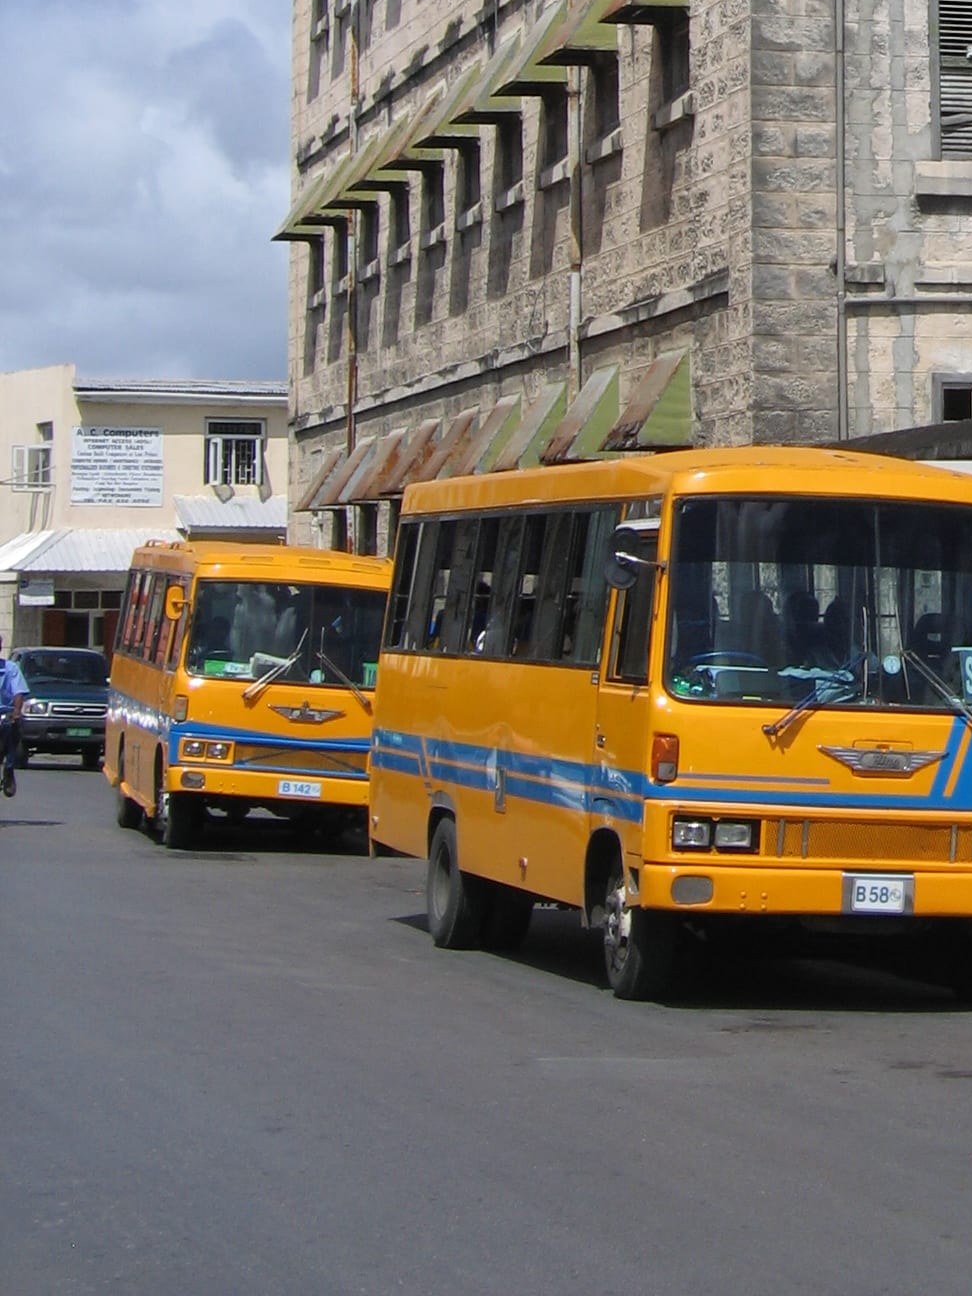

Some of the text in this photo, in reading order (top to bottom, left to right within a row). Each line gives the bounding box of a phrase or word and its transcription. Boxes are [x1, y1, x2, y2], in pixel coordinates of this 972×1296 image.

[104, 429, 160, 438] Computers
[282, 782, 311, 794] B 142
[856, 886, 889, 903] B 58
